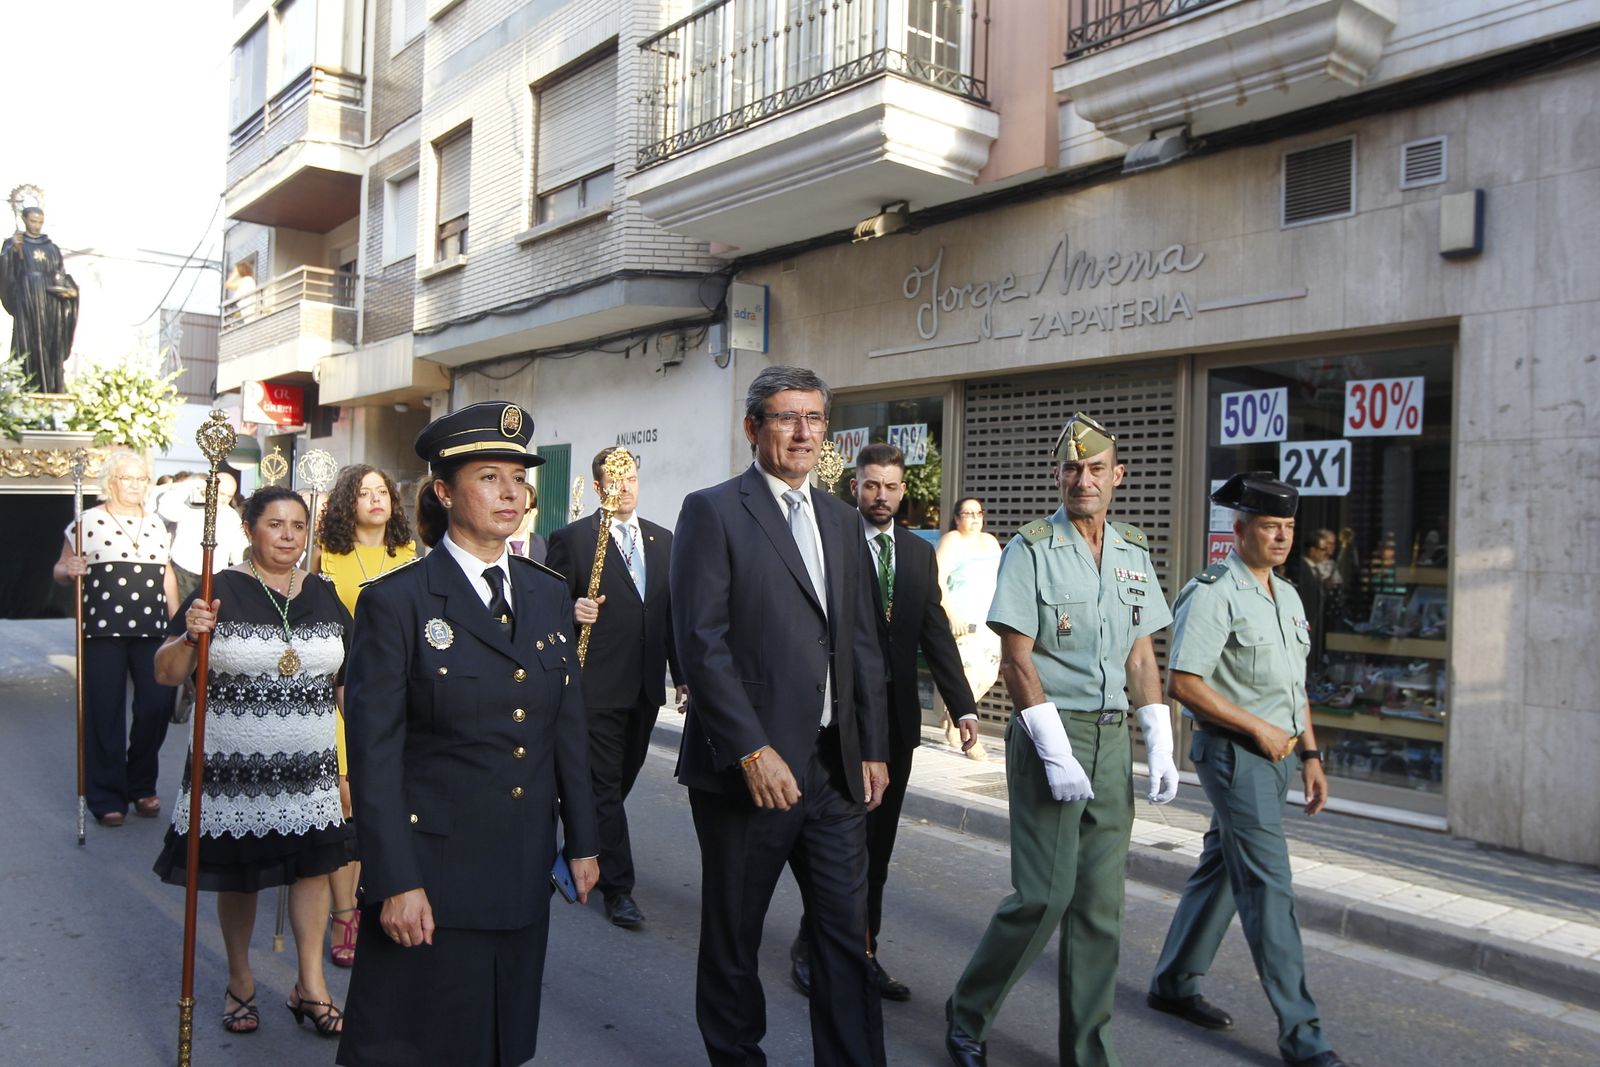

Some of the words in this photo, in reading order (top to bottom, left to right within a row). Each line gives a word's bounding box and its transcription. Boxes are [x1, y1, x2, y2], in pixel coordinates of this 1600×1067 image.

[903, 246, 1030, 341] Jorge
[1036, 233, 1206, 297] Mena
[734, 307, 758, 320] adra
[1027, 291, 1194, 341] ZAPATERIA
[1223, 391, 1285, 439] 50%
[1348, 380, 1419, 431] 30%
[615, 428, 658, 448] ANUNCIOS
[889, 426, 925, 461] 50%
[1284, 446, 1347, 489] 2X1
